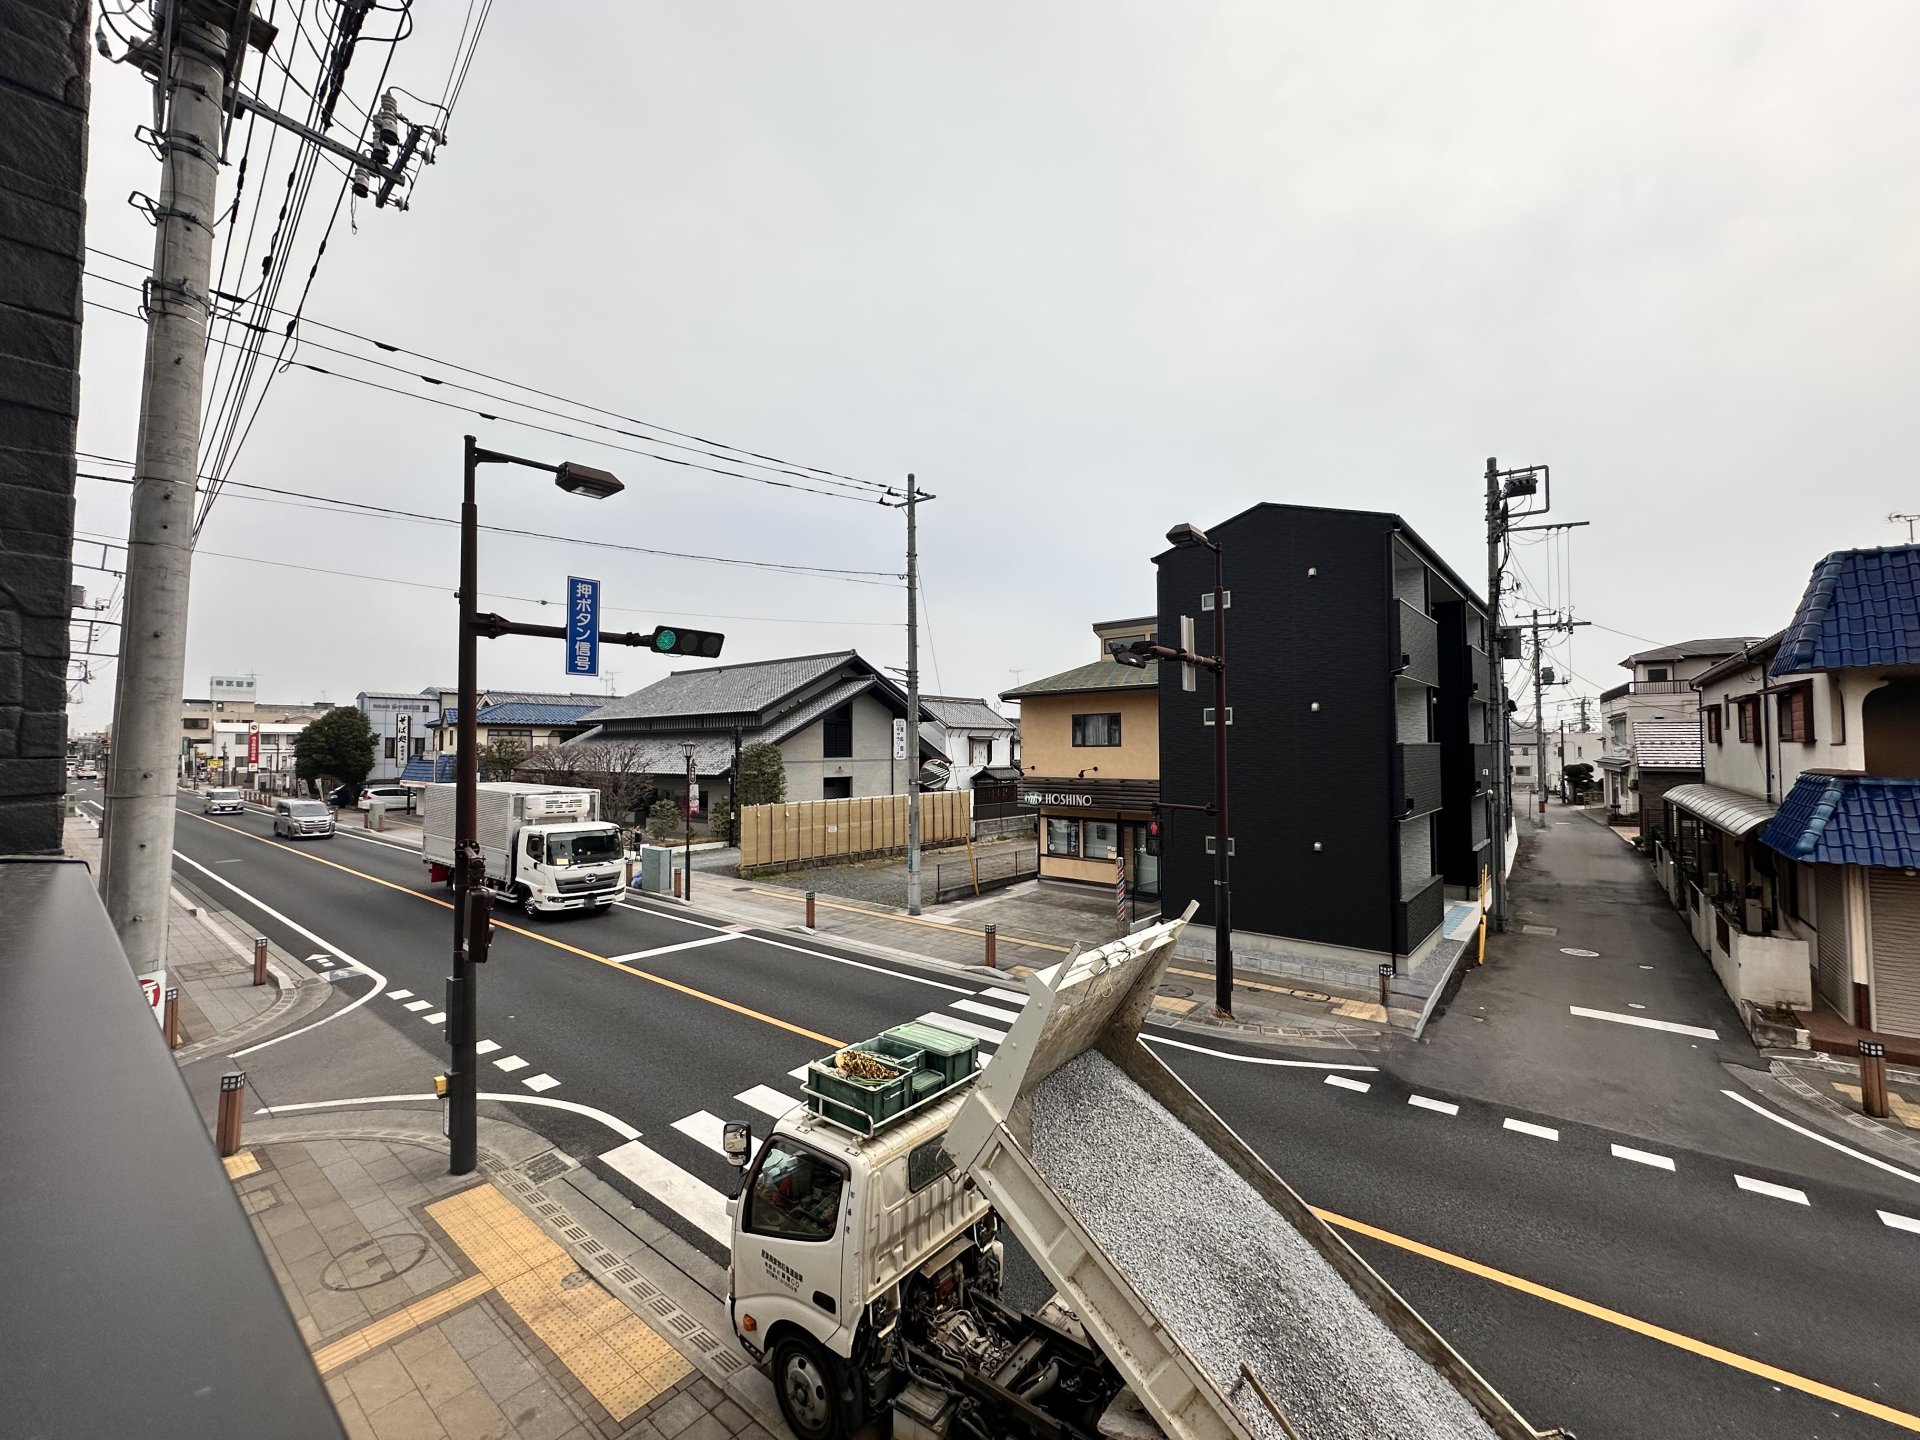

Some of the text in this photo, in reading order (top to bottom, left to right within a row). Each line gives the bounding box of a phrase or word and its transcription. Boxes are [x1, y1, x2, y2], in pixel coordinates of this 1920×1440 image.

[575, 583, 592, 671] 押ボタン信号
[398, 715, 407, 743] そば処
[1045, 793, 1092, 806] HOSHINO
